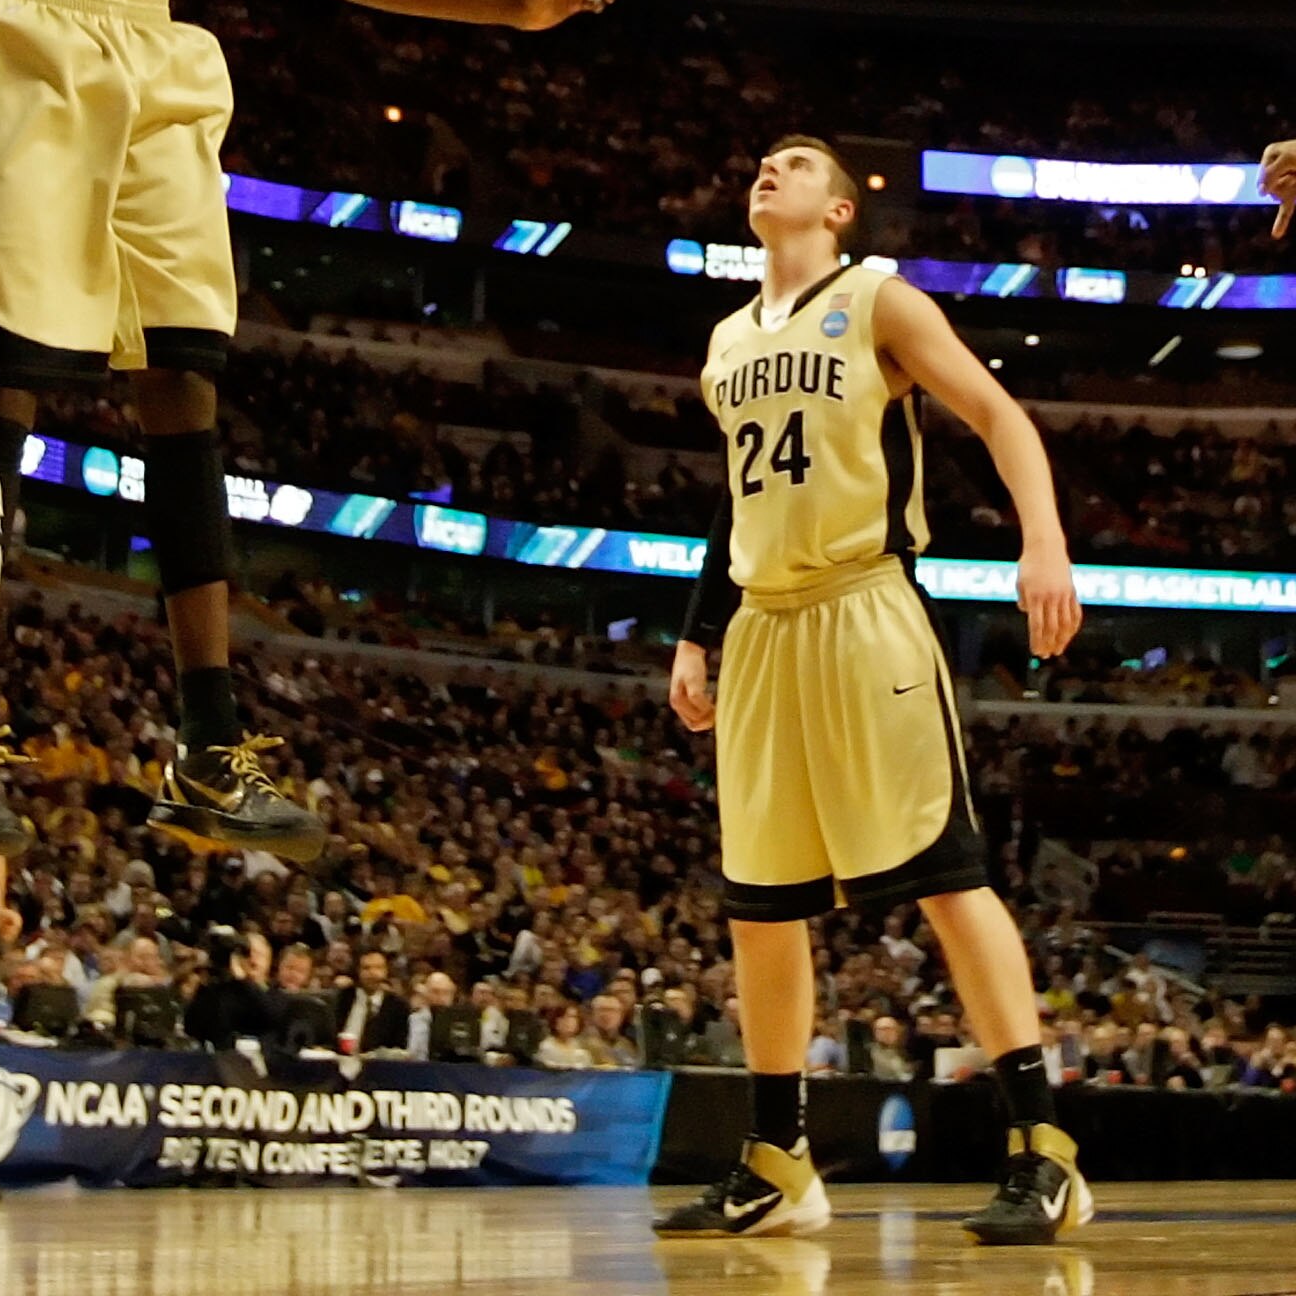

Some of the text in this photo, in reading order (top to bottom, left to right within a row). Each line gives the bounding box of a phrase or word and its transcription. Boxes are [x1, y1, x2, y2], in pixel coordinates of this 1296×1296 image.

[716, 351, 846, 408] PURDUE
[736, 410, 811, 497] 24
[158, 1083, 300, 1133] SECOND
[297, 1090, 375, 1134] AND
[372, 1090, 463, 1132] THIRD
[464, 1093, 577, 1133] ROUNDS
[205, 1137, 260, 1173] TEN
